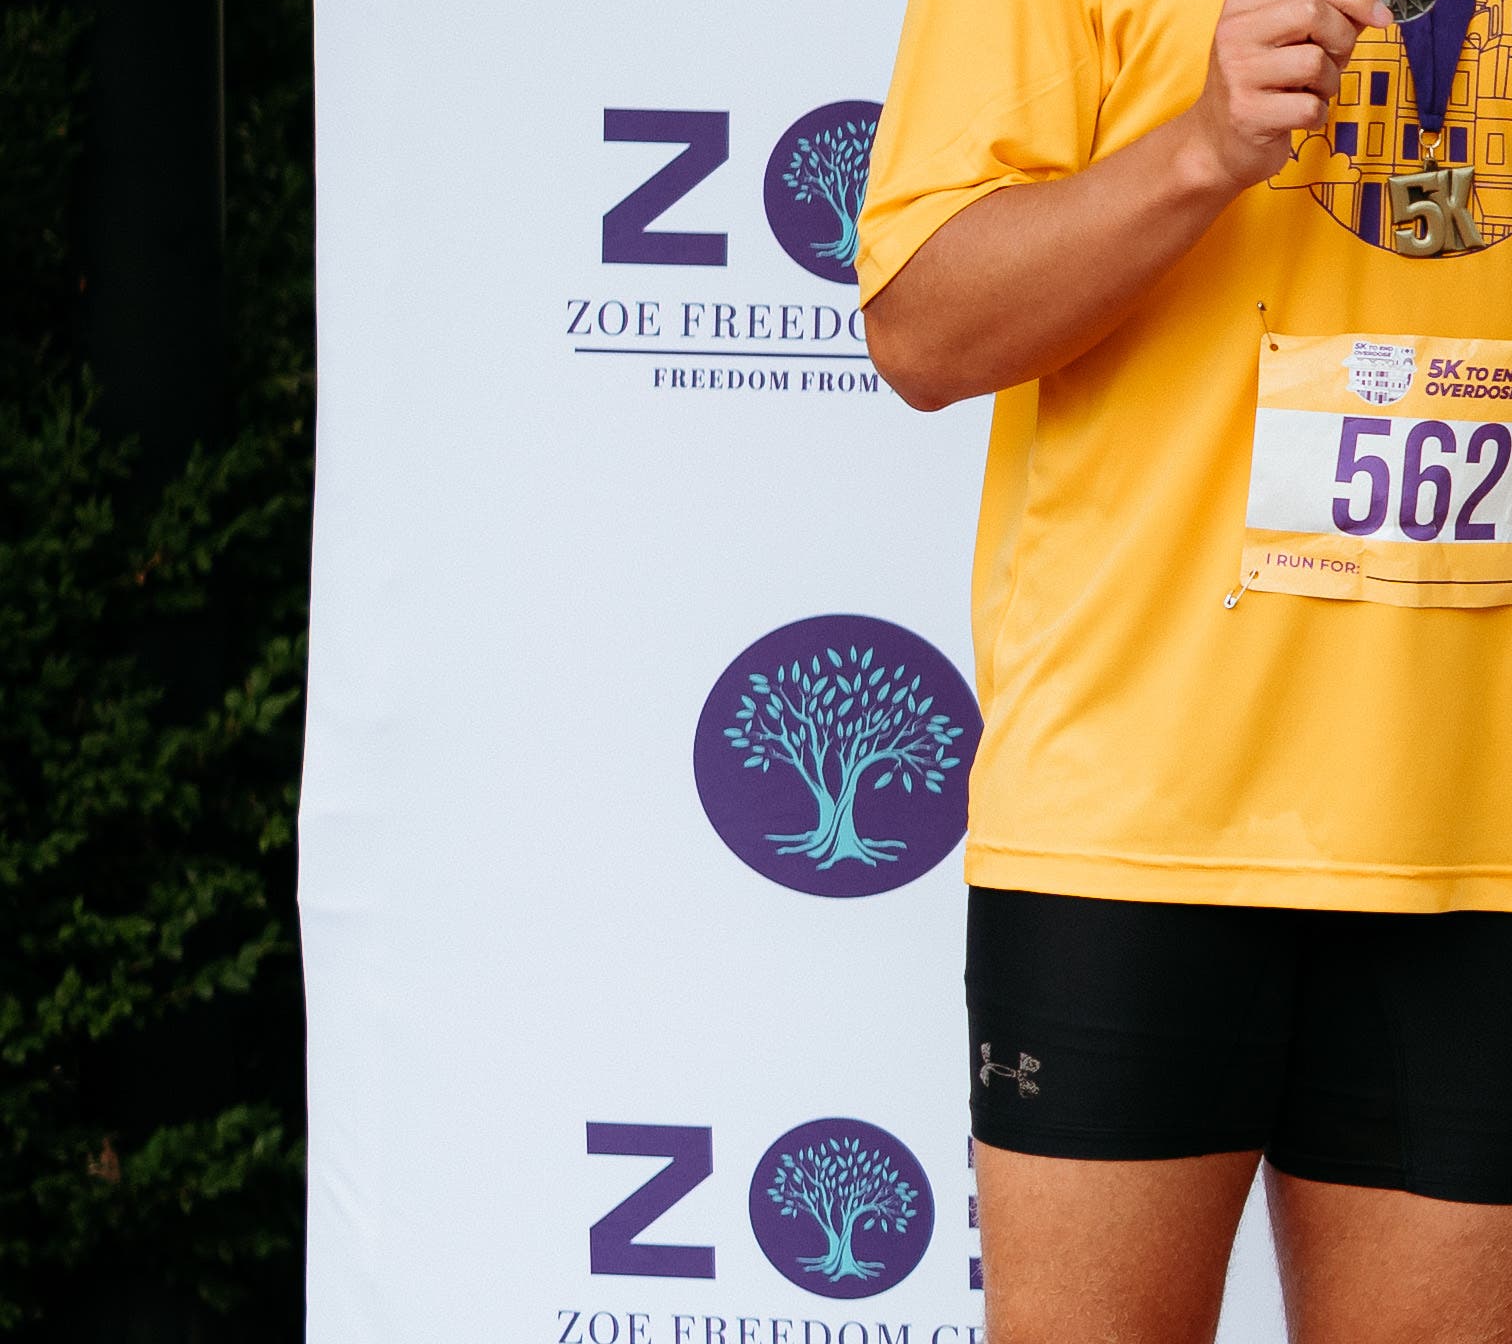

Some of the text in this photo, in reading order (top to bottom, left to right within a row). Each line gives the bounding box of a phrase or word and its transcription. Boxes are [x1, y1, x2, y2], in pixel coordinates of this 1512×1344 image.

[602, 100, 884, 285] ZO
[1388, 166, 1487, 257] 5K
[565, 299, 866, 343] ZOE FREEDO
[653, 367, 880, 394] FREEDOM FROM
[1427, 358, 1467, 381] 5K
[1466, 366, 1489, 382] TO
[1331, 415, 1512, 542] 562
[1276, 553, 1314, 570] RUN
[1320, 558, 1361, 575] FOR:
[586, 1116, 985, 1300] ZO
